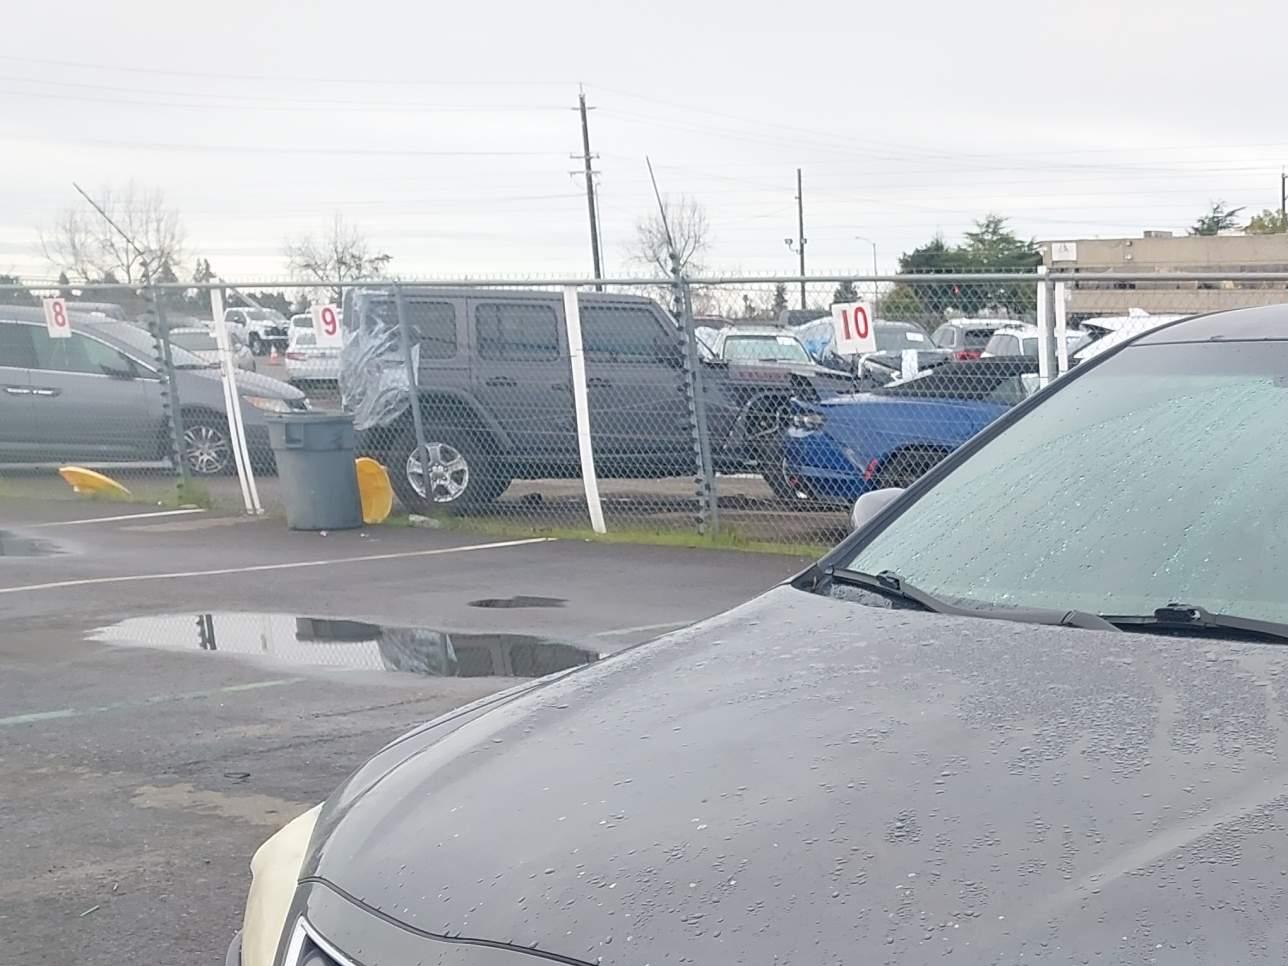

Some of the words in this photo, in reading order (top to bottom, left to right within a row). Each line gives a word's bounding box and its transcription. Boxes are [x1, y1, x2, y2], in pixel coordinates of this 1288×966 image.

[52, 301, 66, 327] 8
[321, 307, 337, 336] 9
[841, 306, 869, 340] 10
